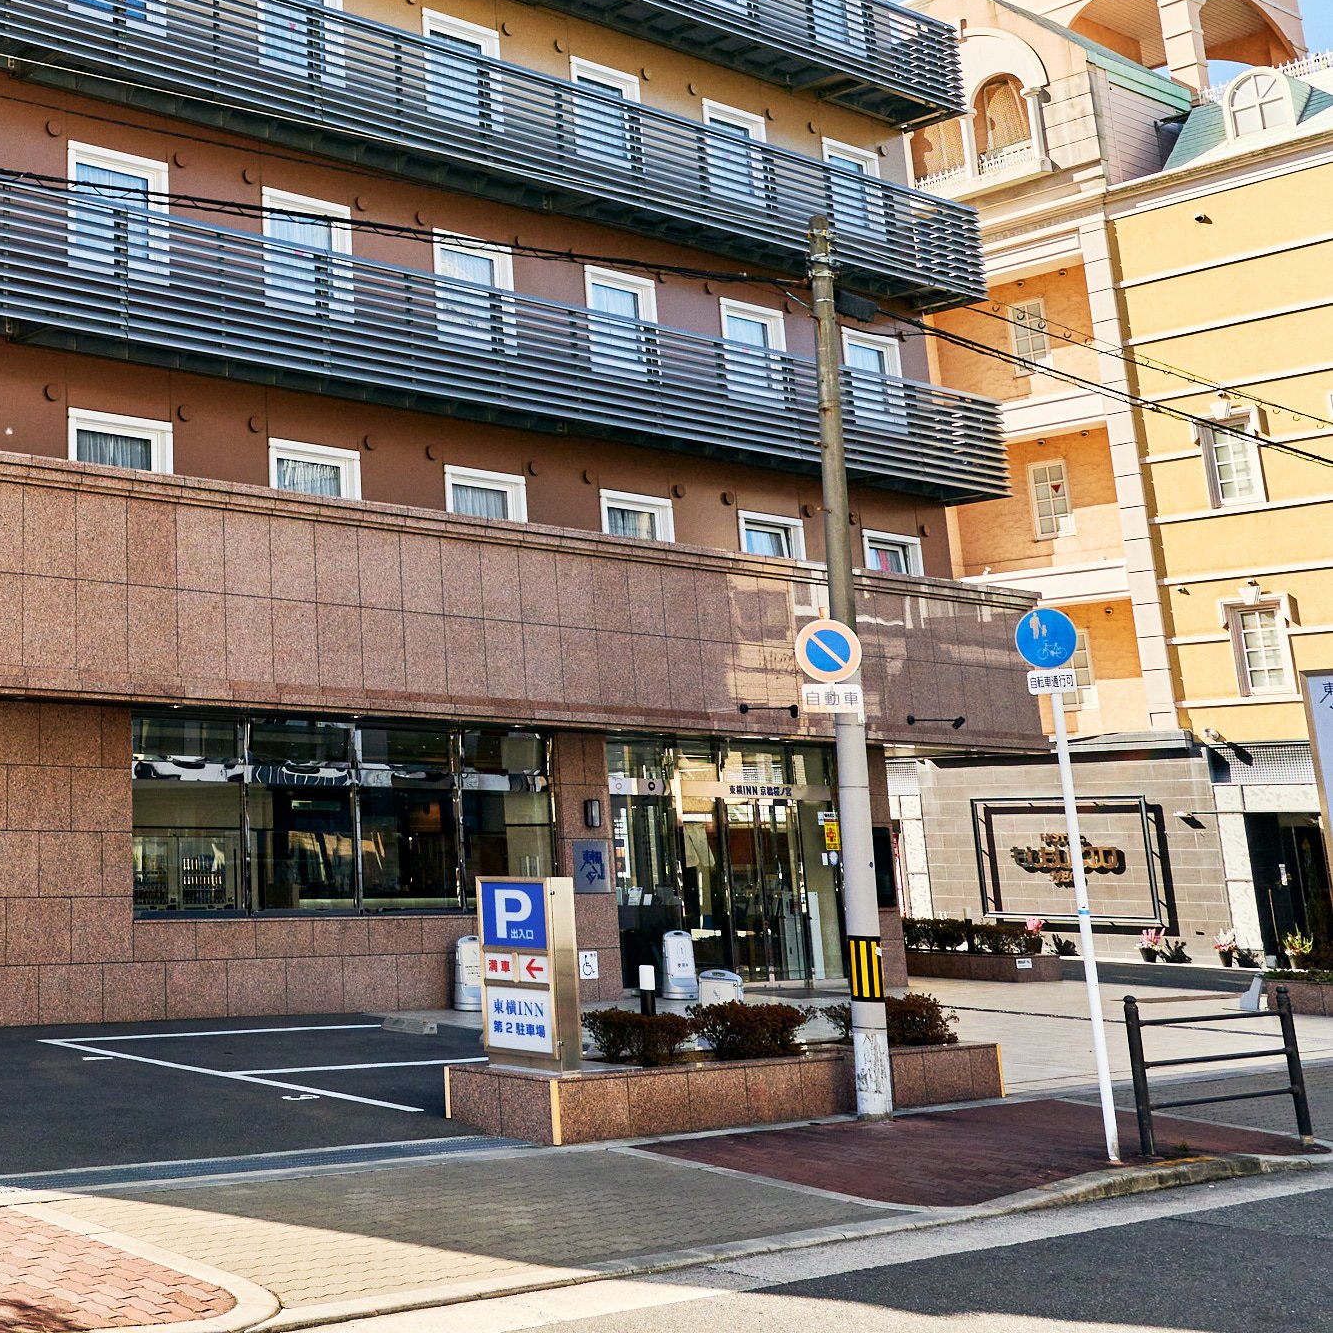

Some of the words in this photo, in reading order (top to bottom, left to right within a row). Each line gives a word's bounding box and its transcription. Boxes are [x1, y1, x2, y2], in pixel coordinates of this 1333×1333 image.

[1030, 674, 1074, 689] 自転車通行可
[806, 691, 859, 706] 自動車
[494, 888, 533, 939] P
[510, 928, 534, 940] 出入口
[488, 959, 511, 973] 満車
[493, 998, 544, 1017] 東横INN
